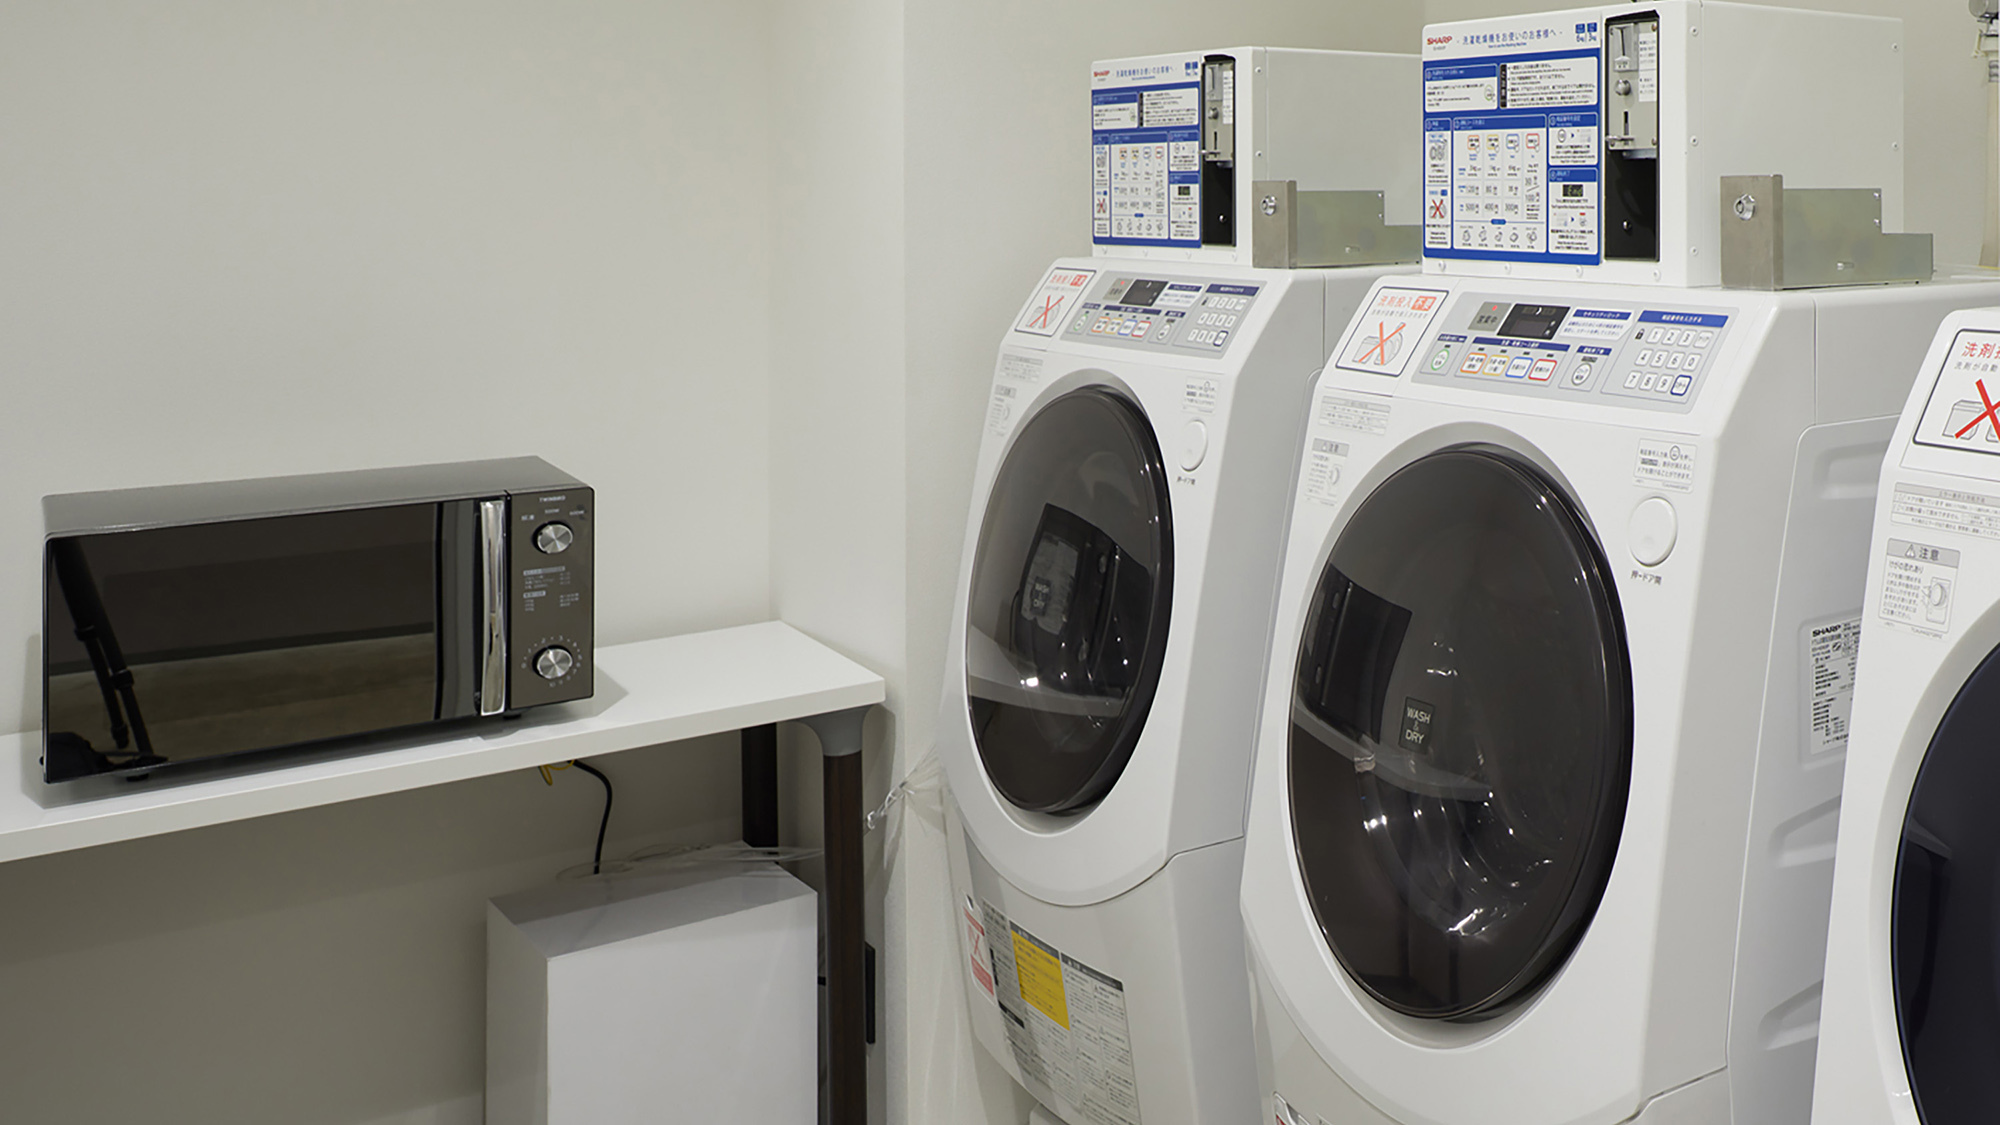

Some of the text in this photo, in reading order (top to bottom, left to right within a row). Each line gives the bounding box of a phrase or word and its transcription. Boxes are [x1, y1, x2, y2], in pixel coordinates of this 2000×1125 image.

[1427, 36, 1452, 45] SHARP
[1667, 332, 1674, 341] 2
[1683, 333, 1690, 342] 3
[1656, 354, 1663, 363] 5
[1672, 356, 1678, 365] 6
[1688, 357, 1695, 367] 0
[1644, 376, 1651, 386] 8
[1660, 378, 1668, 388] 9
[1919, 547, 1939, 561] 注意
[1812, 624, 1842, 637] SHARP
[1407, 707, 1431, 724] WASH
[1405, 729, 1424, 744] DRY
